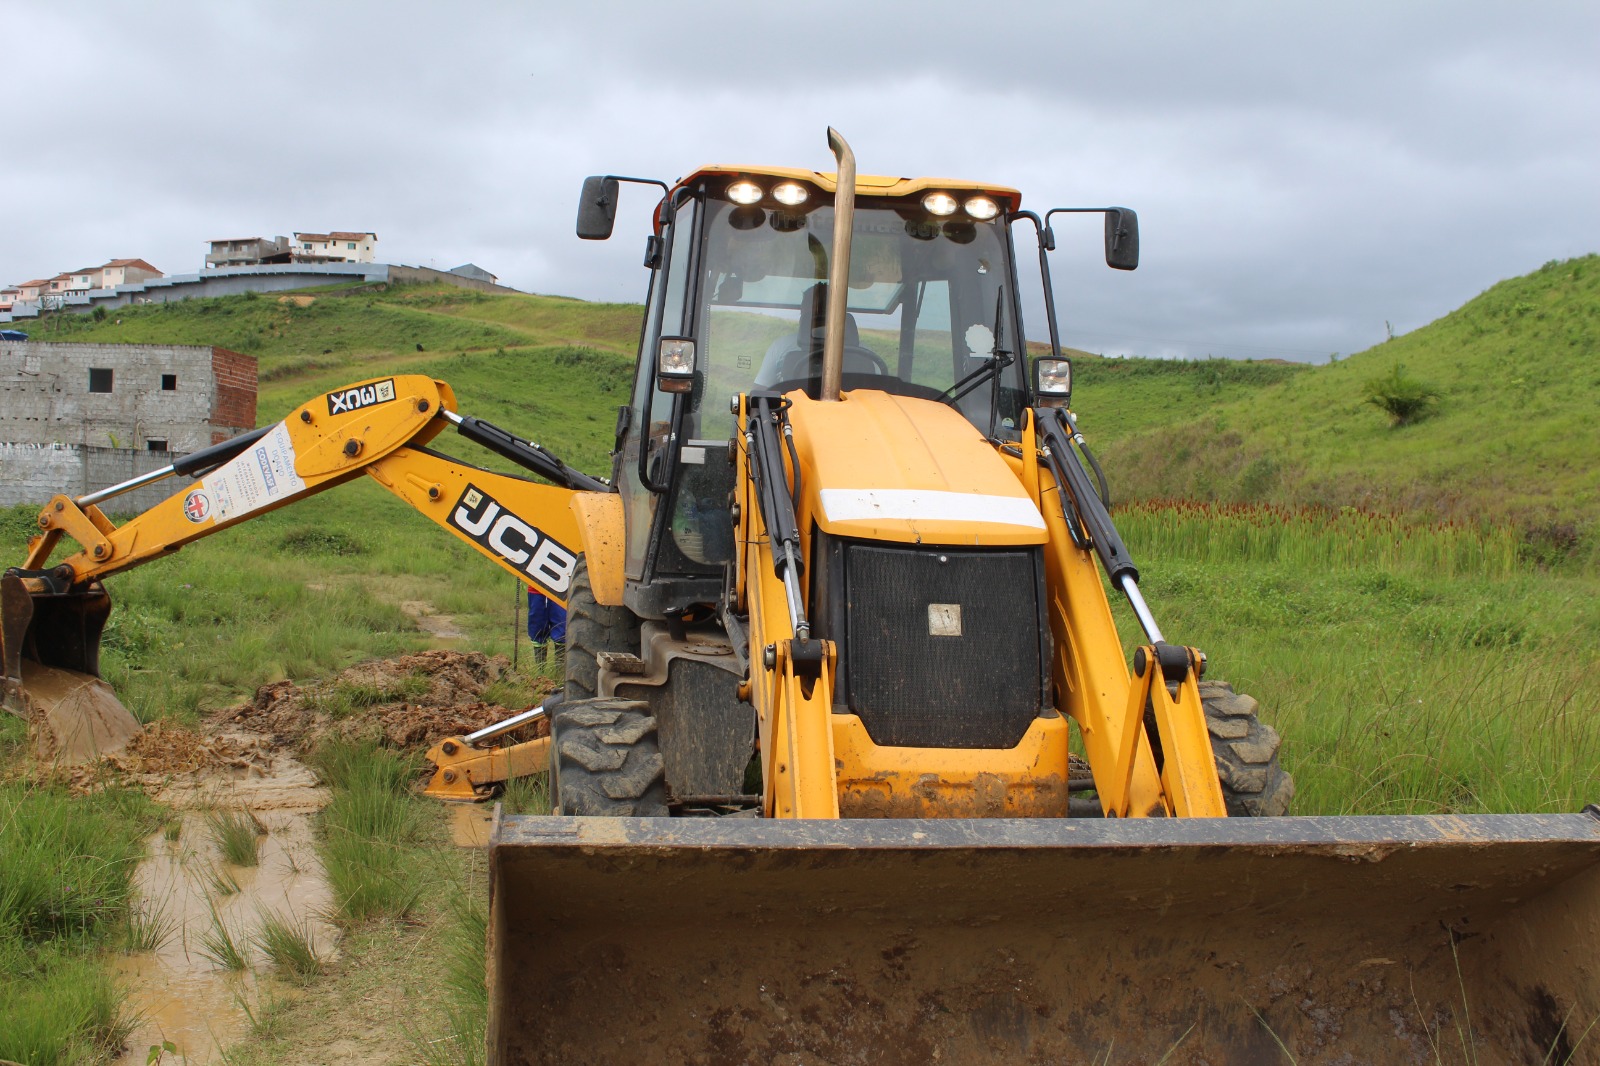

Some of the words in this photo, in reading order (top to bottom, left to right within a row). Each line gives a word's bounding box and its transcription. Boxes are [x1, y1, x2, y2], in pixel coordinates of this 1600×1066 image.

[330, 386, 376, 415] 3CX
[257, 448, 275, 487] CODEVASF
[272, 449, 284, 476] DOADO
[276, 432, 297, 486] EQUIPAMENTO
[454, 501, 577, 593] JCB
